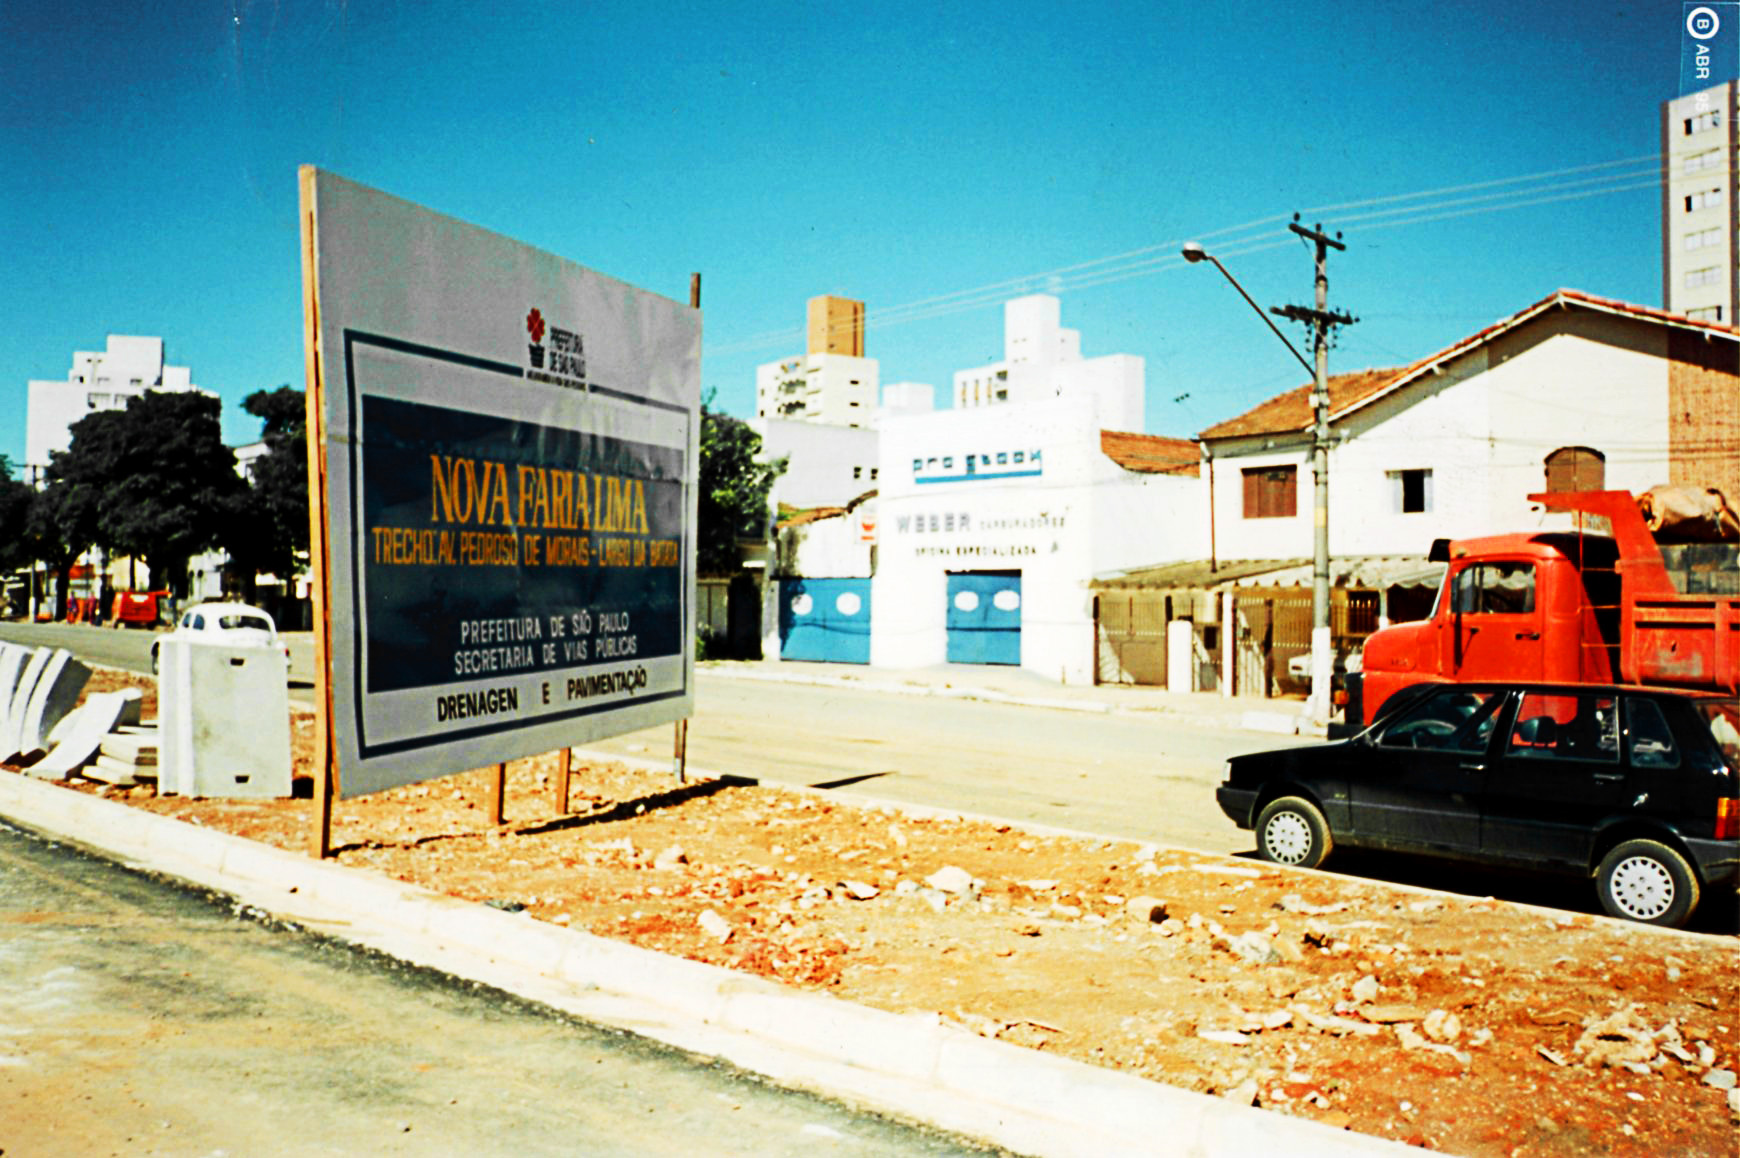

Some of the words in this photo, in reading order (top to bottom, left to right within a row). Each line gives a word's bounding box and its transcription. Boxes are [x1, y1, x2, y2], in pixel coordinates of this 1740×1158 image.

[430, 455, 513, 526] NOVA
[517, 463, 590, 531] FARIA
[593, 473, 650, 535] LIMA
[896, 512, 970, 534] WEBER
[460, 531, 518, 566] PEDROSO
[524, 534, 540, 566] DE
[546, 535, 589, 567] MORAIS
[461, 616, 542, 645] PREFEITURA
[551, 615, 566, 638] DE
[572, 609, 592, 637] SÃO
[600, 611, 630, 633] PAULO
[454, 645, 535, 675] SECRETARIA
[543, 643, 556, 665] DE
[564, 640, 588, 662] VIAS
[596, 633, 638, 659] PÚBLICAS
[436, 686, 518, 723] DRENAGEN
[541, 681, 551, 705] E
[567, 664, 648, 701] PAVIMENTAÇÃO
